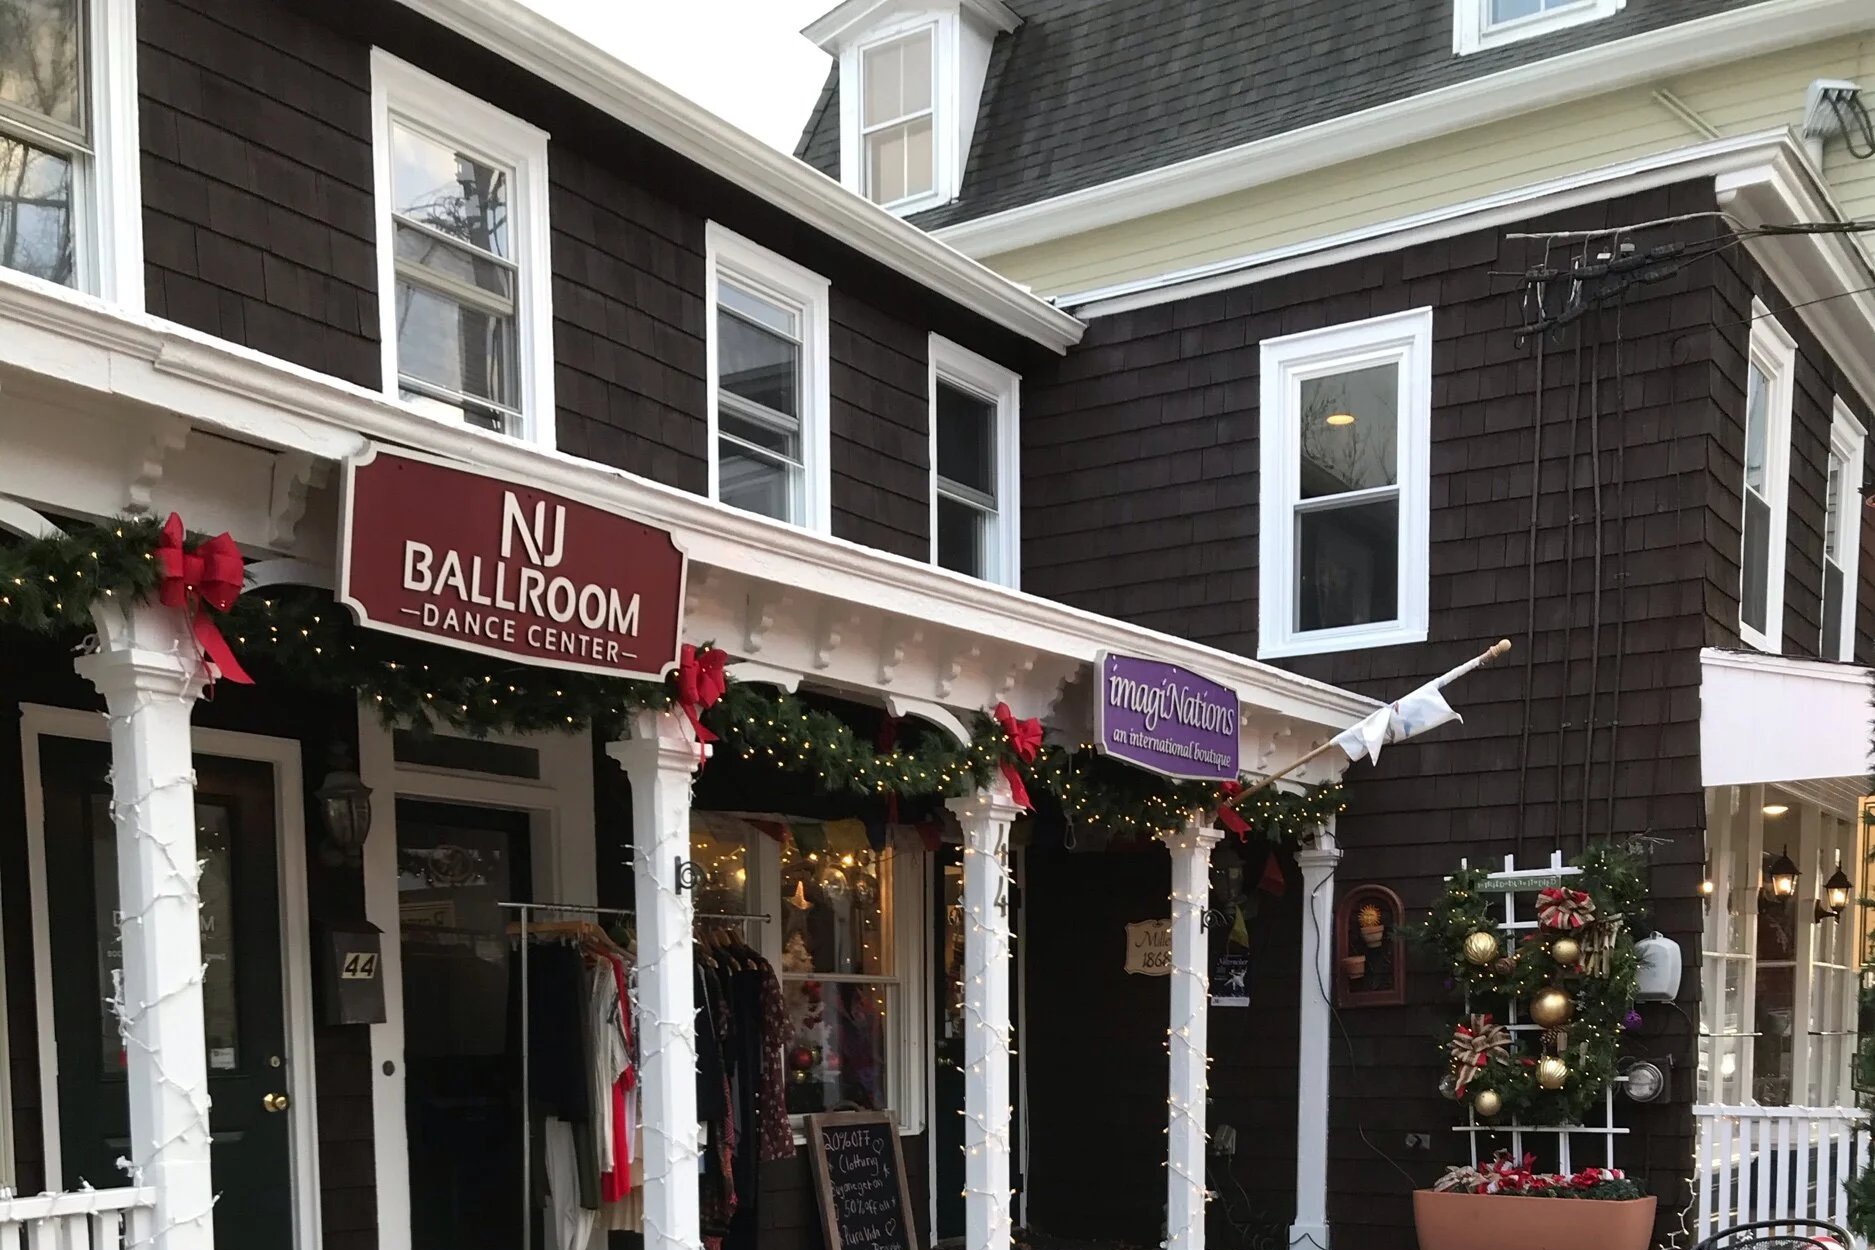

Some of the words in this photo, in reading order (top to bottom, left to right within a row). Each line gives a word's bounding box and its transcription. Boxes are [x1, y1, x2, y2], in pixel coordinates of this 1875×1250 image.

[501, 490, 566, 567] NJ
[403, 539, 640, 637] BALLROOM
[423, 603, 515, 643] DANCE
[528, 625, 619, 663] CENTER
[1109, 664, 1234, 736] imagiNations
[1113, 728, 1127, 743] an
[1130, 728, 1193, 759] international
[1194, 743, 1231, 771] boutique
[344, 954, 377, 976] 44
